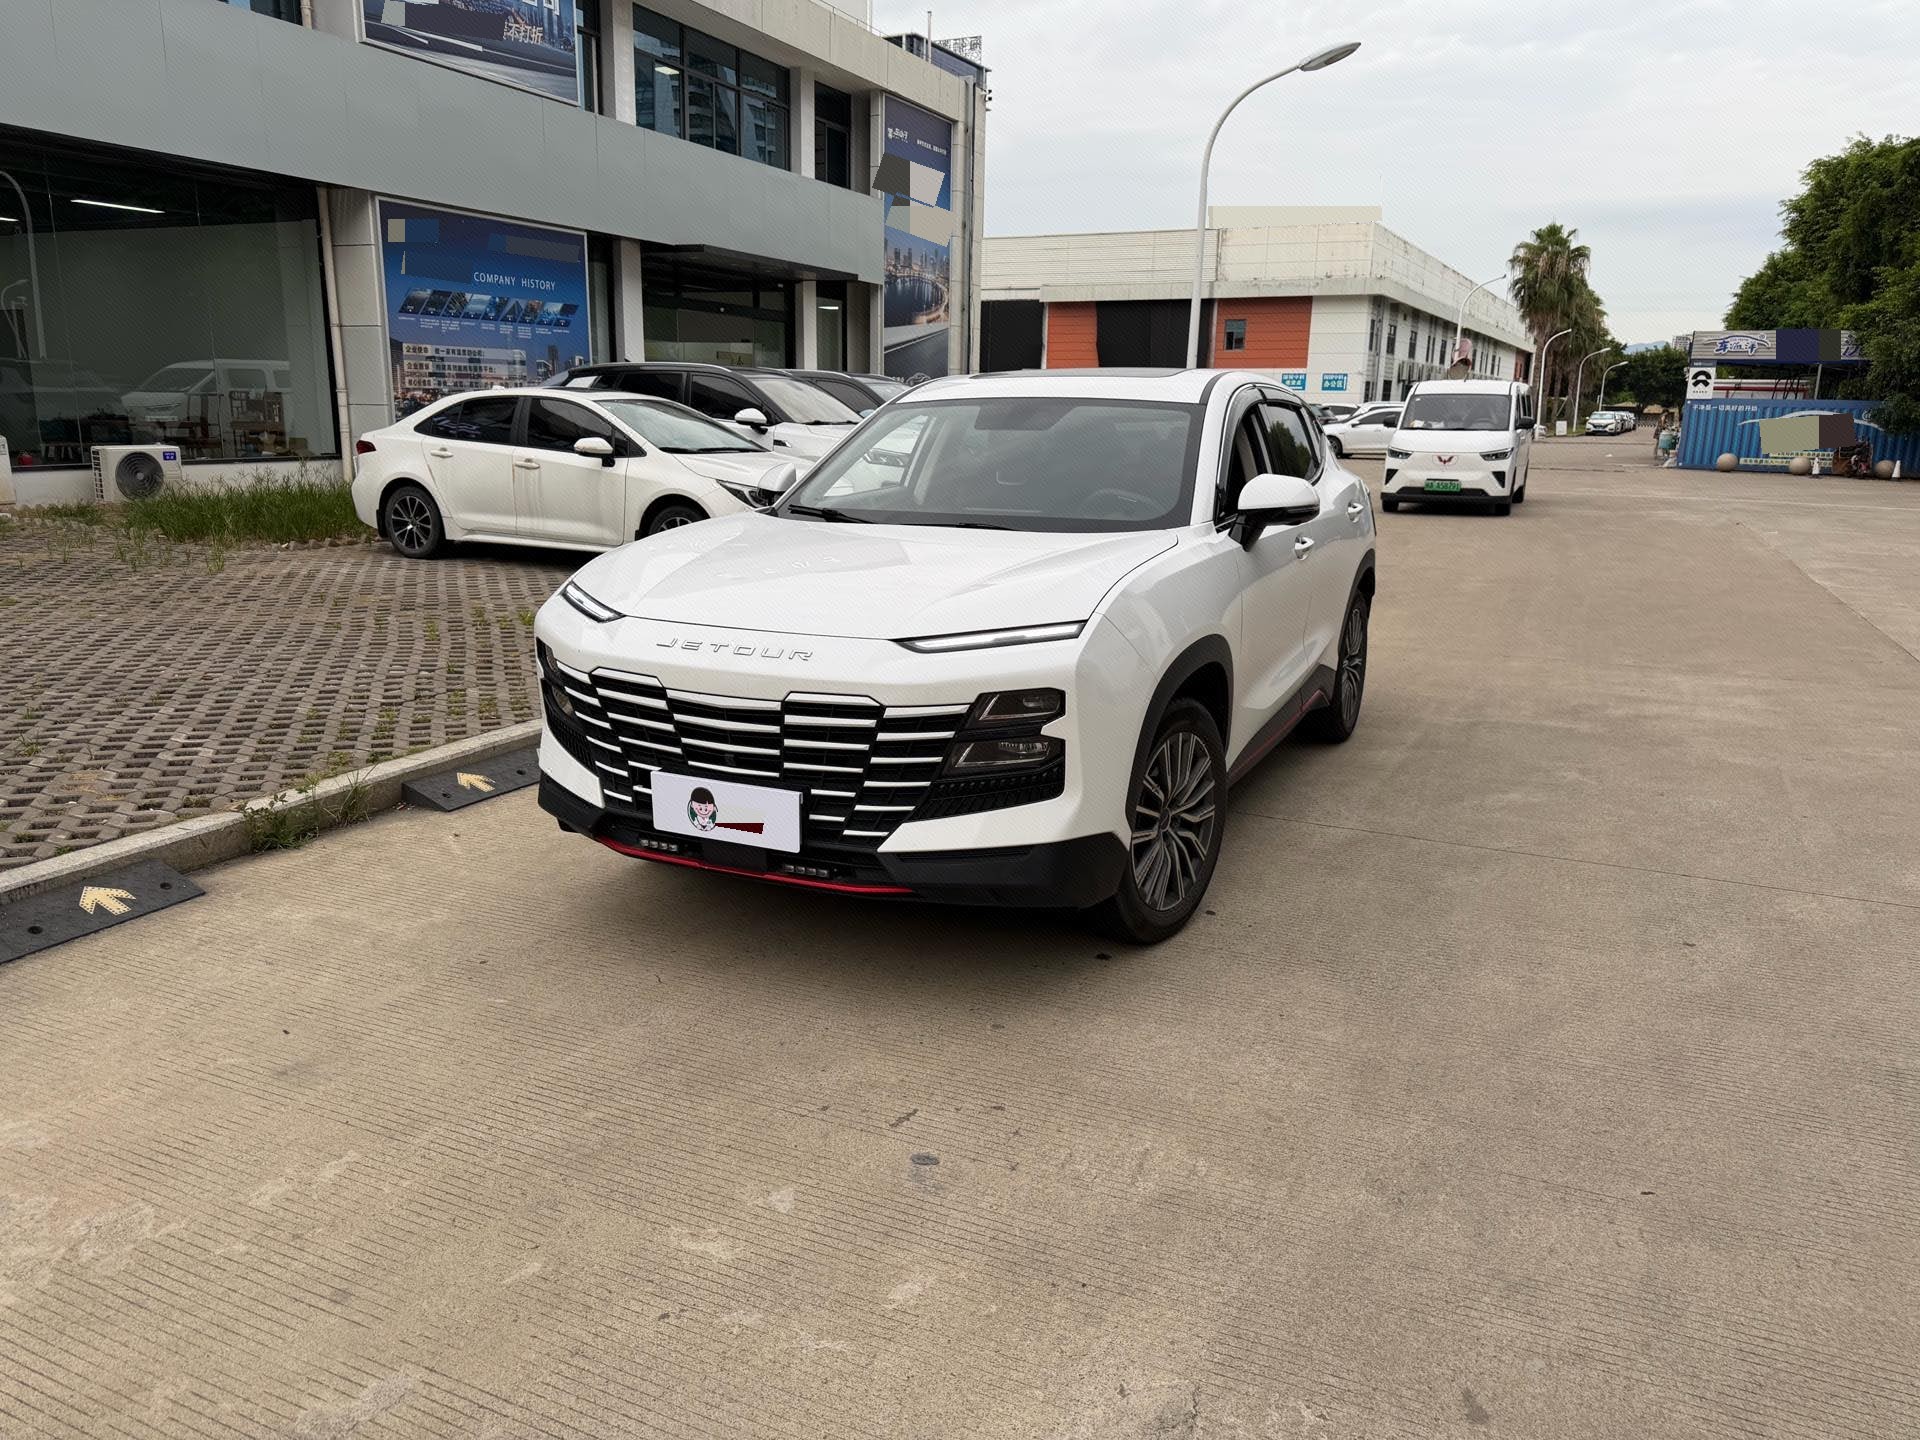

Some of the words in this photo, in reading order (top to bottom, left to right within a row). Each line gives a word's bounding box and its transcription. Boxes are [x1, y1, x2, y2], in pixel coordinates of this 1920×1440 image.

[473, 271, 516, 286] COMPANY
[521, 278, 556, 291] HISTORY
[656, 638, 813, 661] JETOUR
